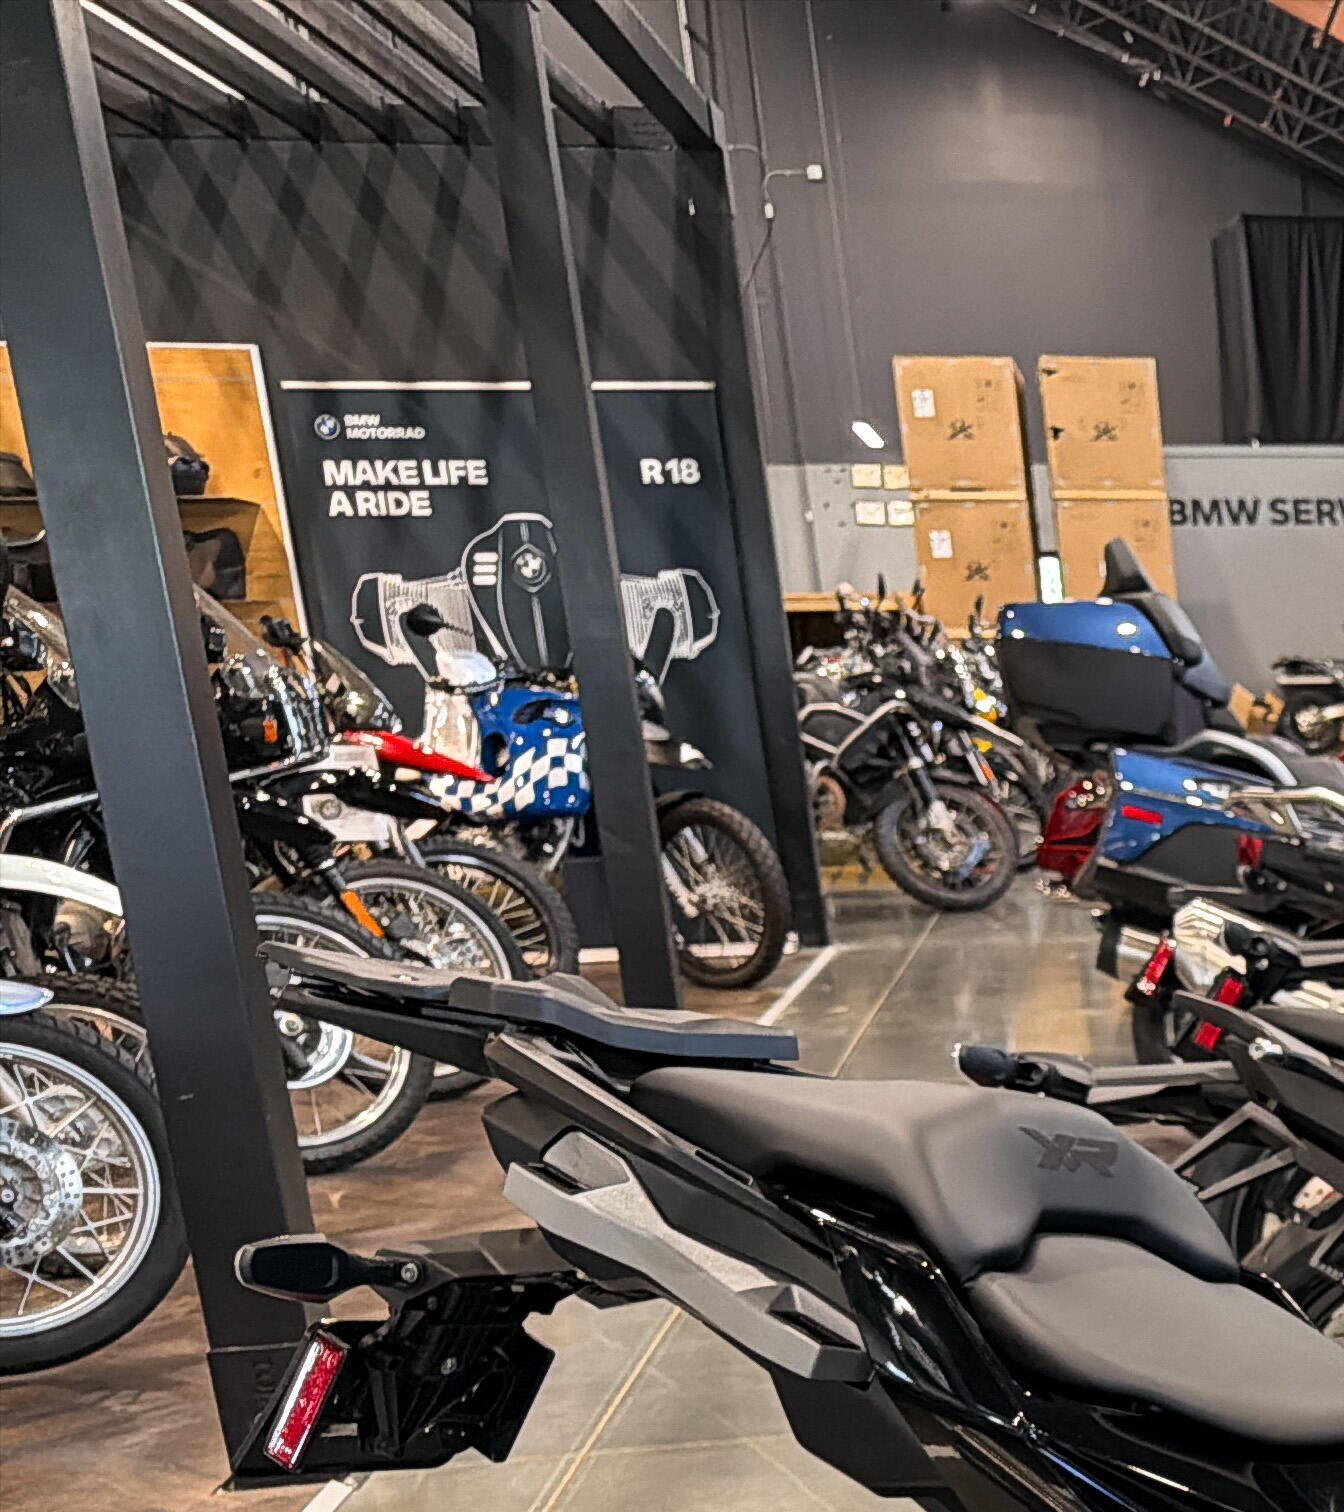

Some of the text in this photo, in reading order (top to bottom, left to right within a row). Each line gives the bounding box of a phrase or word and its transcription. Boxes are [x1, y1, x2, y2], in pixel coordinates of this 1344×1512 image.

[346, 426, 426, 440] MOTORRAD
[322, 459, 489, 486] MAKE LIFE
[640, 457, 701, 485] R 18
[328, 490, 433, 517] A RIDE
[1169, 497, 1259, 527] BMW
